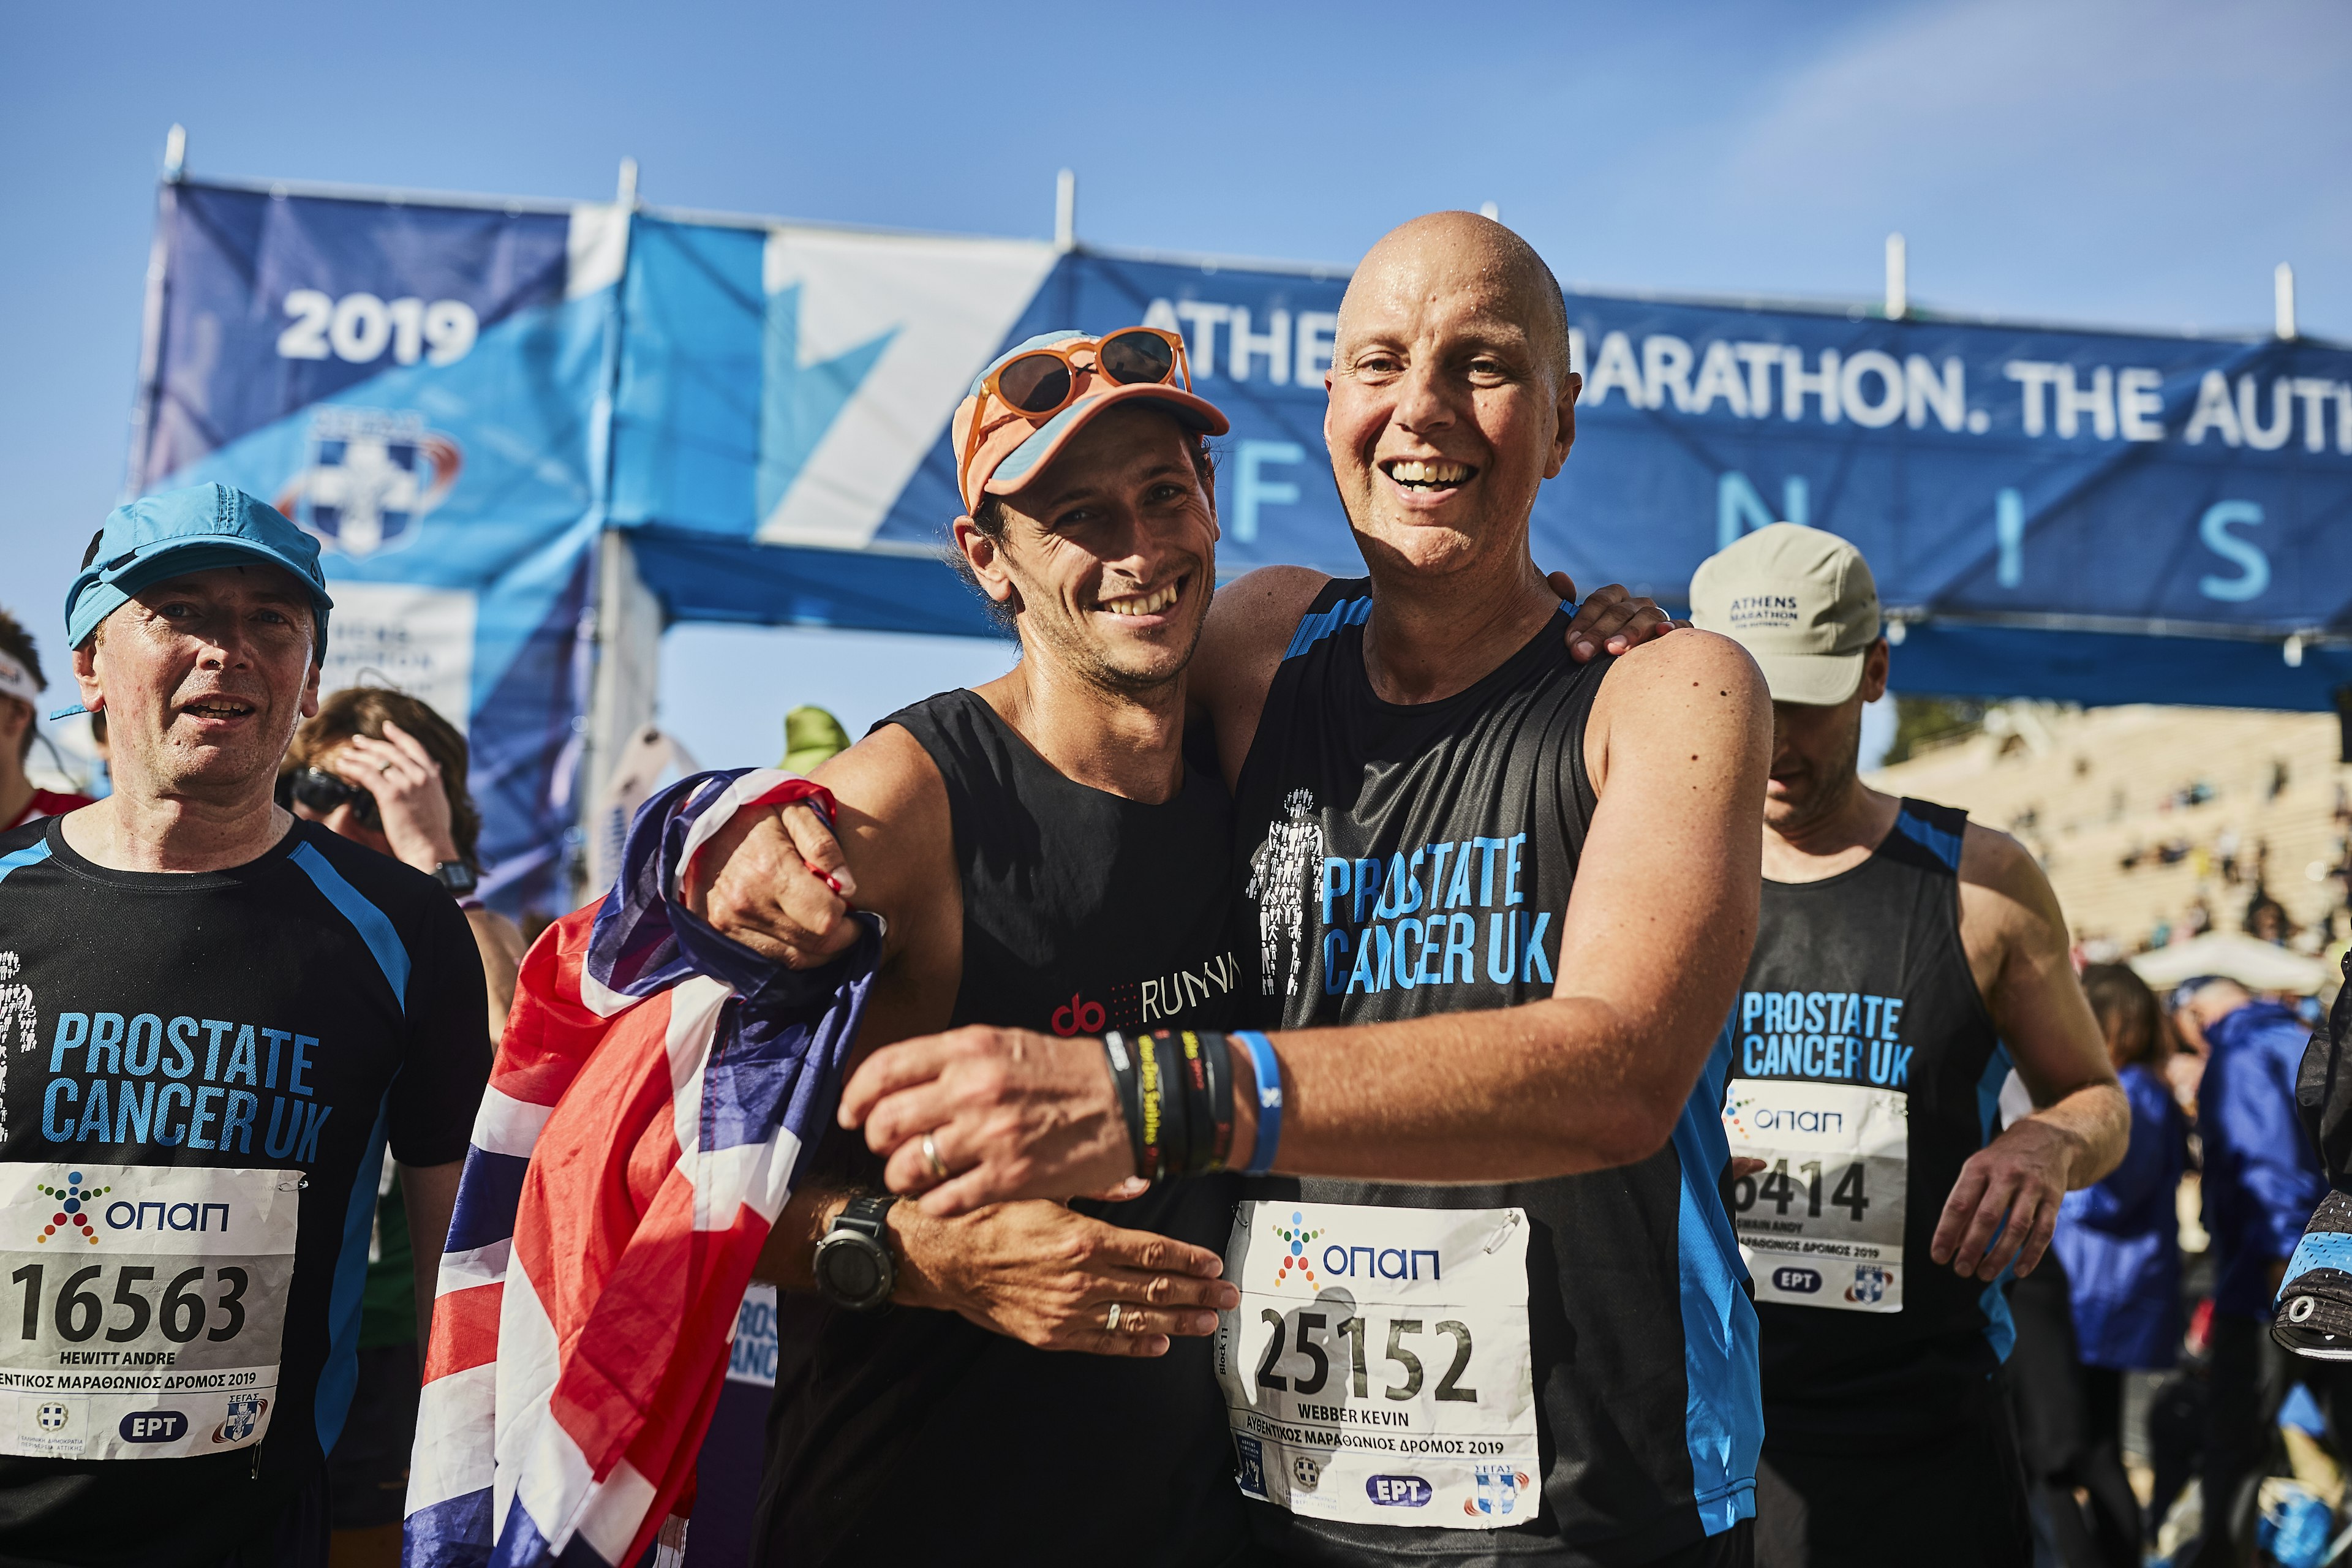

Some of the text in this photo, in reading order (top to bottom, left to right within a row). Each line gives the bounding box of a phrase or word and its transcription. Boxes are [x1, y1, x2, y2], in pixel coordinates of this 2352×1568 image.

[277, 288, 478, 366] 2019
[2003, 359, 2166, 443] THE
[1731, 595, 1796, 610] ATHENS
[1322, 832, 1526, 925] PROSTATE
[1323, 909, 1554, 995] CANCER UK
[1743, 991, 1904, 1041] PROSTATE
[48, 1012, 320, 1097] PROSTATE
[1743, 1033, 1914, 1088] CANCER UK
[42, 1077, 333, 1163] CANCER UK
[1803, 1242, 1851, 1256] ΔΡΟΜΟΣ
[1853, 1247, 1880, 1259] 2019
[12, 1264, 249, 1343] 16563
[1221, 1328, 1228, 1340] 11
[1257, 1308, 1477, 1403] 25152
[58, 1376, 162, 1389] ΜΑΡΑΘΩΝΙΟΣ
[164, 1374, 226, 1389] ΔΡΟΜΟΣ
[228, 1372, 256, 1386] 2019
[60, 1352, 175, 1365] HEWITT ANDRE
[229, 1393, 260, 1403] ΣΕΓΑΣ
[1298, 1403, 1409, 1427] WEBBER KEVIN
[132, 1417, 178, 1437] ΕΡΤ
[1246, 1415, 1504, 1455] ΑΥΘΕΝΤΙΚΟΣ ΜΑΡΑΘΩΝΙΟΣ ΔΡΟΜΟΣ 2019
[1376, 1480, 1421, 1502] ΕΡΤ
